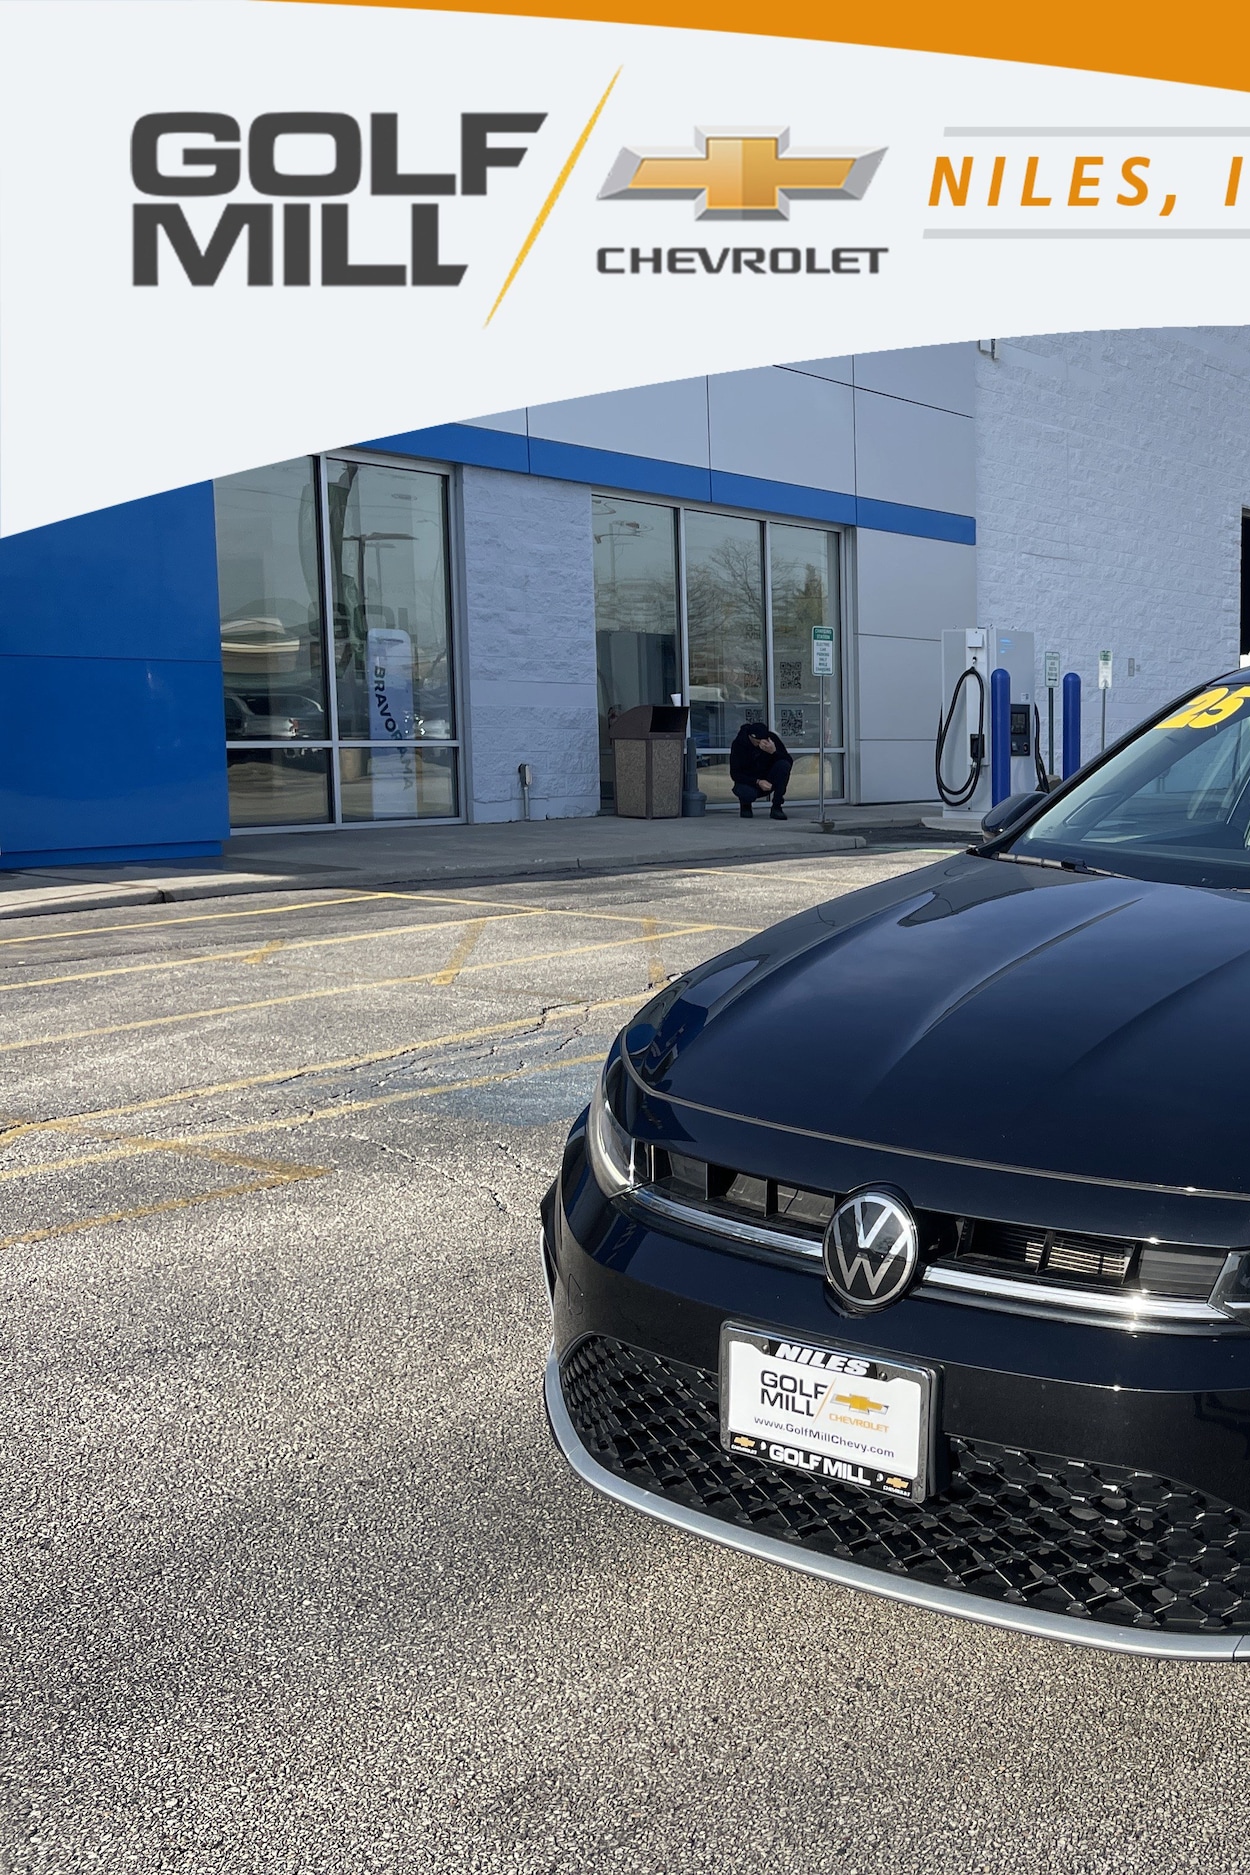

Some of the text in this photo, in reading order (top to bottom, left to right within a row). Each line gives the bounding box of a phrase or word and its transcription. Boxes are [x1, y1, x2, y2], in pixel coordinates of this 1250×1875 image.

[774, 1342, 870, 1376] NILES
[759, 1369, 829, 1400] GOLF
[759, 1388, 816, 1418] MILL
[753, 1416, 896, 1459] www.GolfMillChevy.com
[828, 1412, 890, 1434] CHEVROLET
[768, 1443, 872, 1487] GOLF MILL
